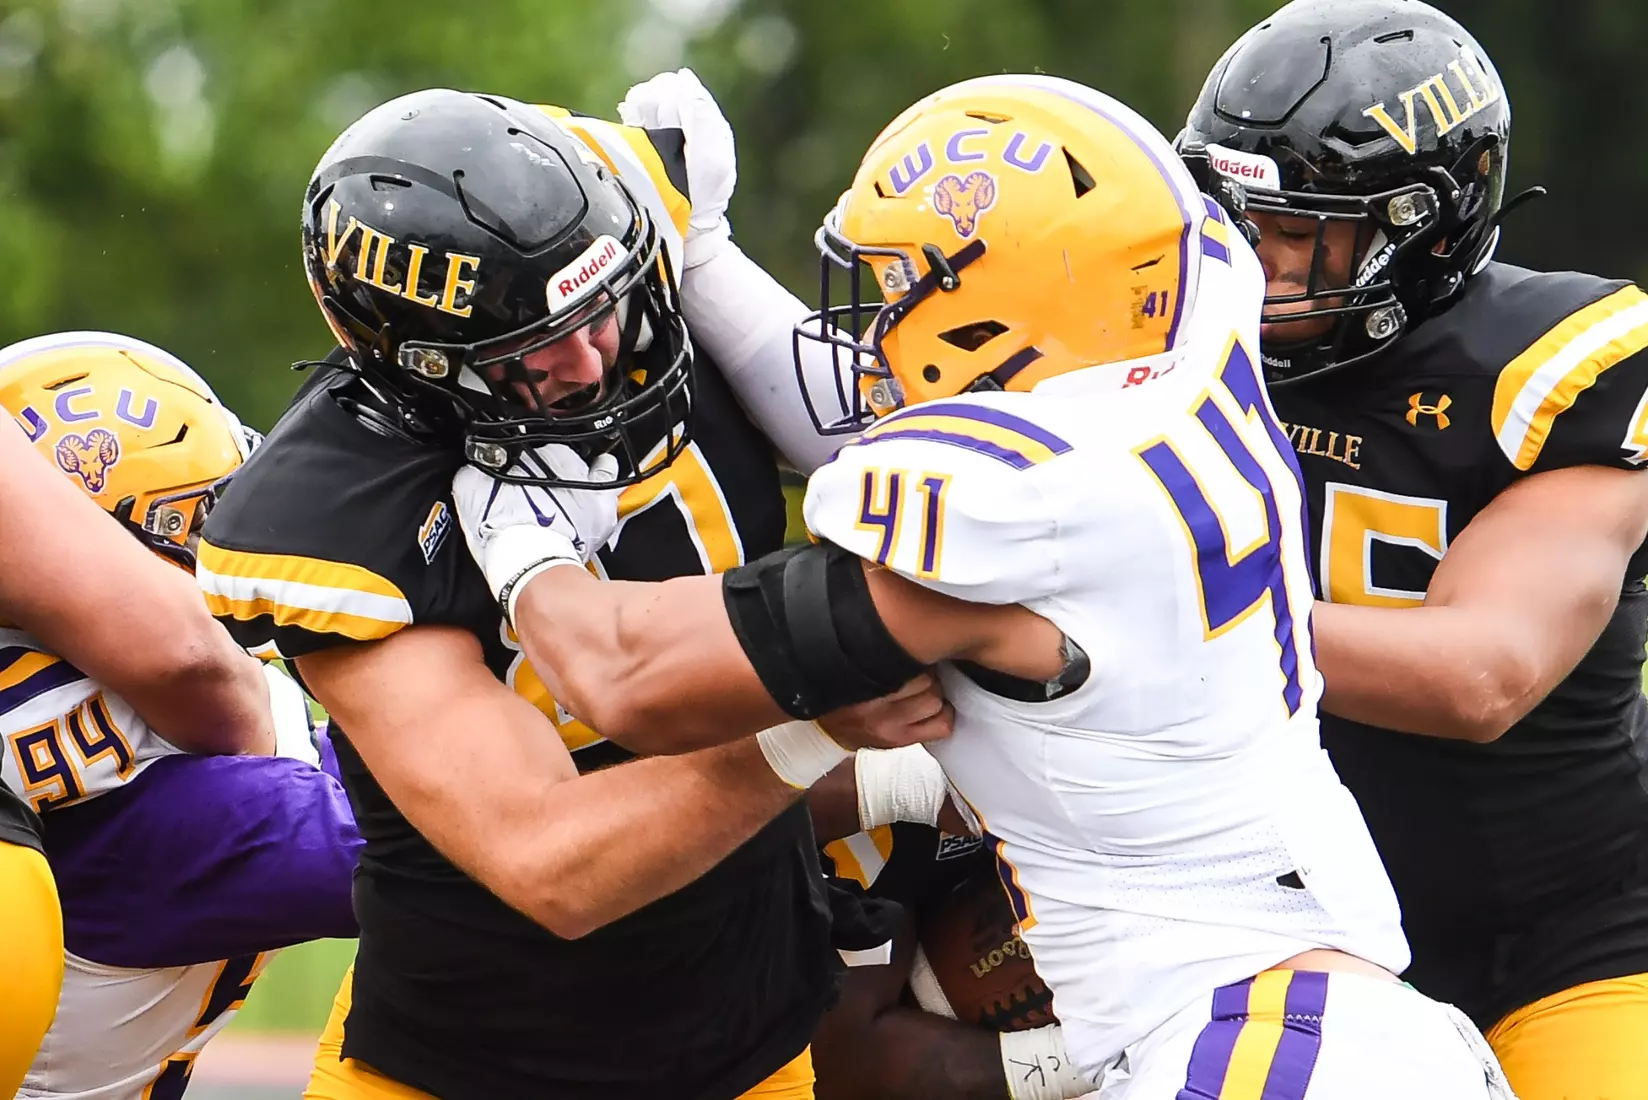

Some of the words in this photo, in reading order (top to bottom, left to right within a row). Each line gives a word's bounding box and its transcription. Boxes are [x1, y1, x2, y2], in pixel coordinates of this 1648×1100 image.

[888, 130, 1052, 194] WCU
[1210, 155, 1265, 179] iddell
[328, 198, 481, 319] VILLE
[558, 241, 617, 298] Riddell
[1141, 290, 1168, 318] 41
[424, 507, 450, 555] PSAC
[854, 465, 953, 581] 41
[8, 690, 136, 816] 94
